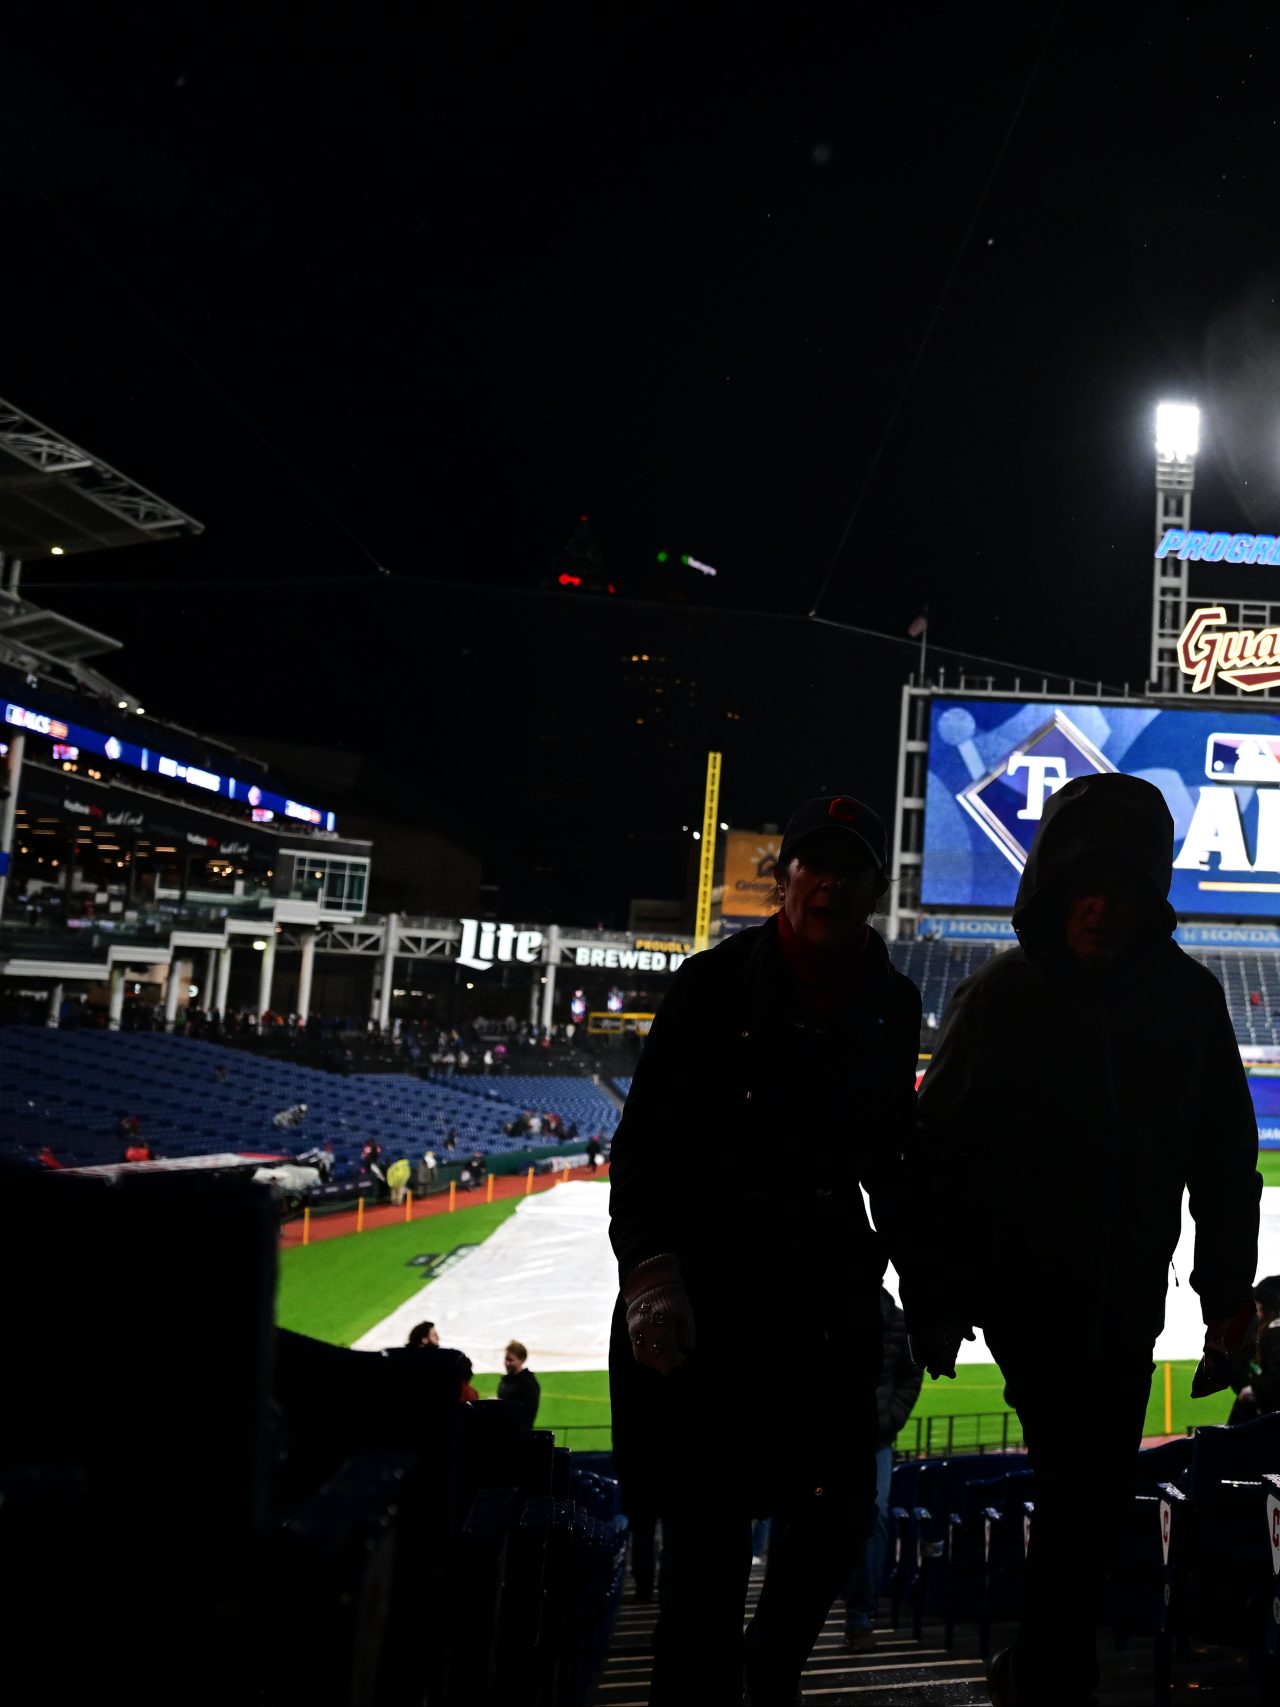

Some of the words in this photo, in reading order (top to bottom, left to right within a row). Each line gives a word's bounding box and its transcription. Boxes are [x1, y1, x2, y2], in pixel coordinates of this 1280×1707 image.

[1007, 755, 1074, 820] T
[949, 920, 1013, 934] HOND
[1201, 929, 1280, 943] HONDA
[455, 918, 543, 971] Lite
[575, 947, 667, 971] BREWED
